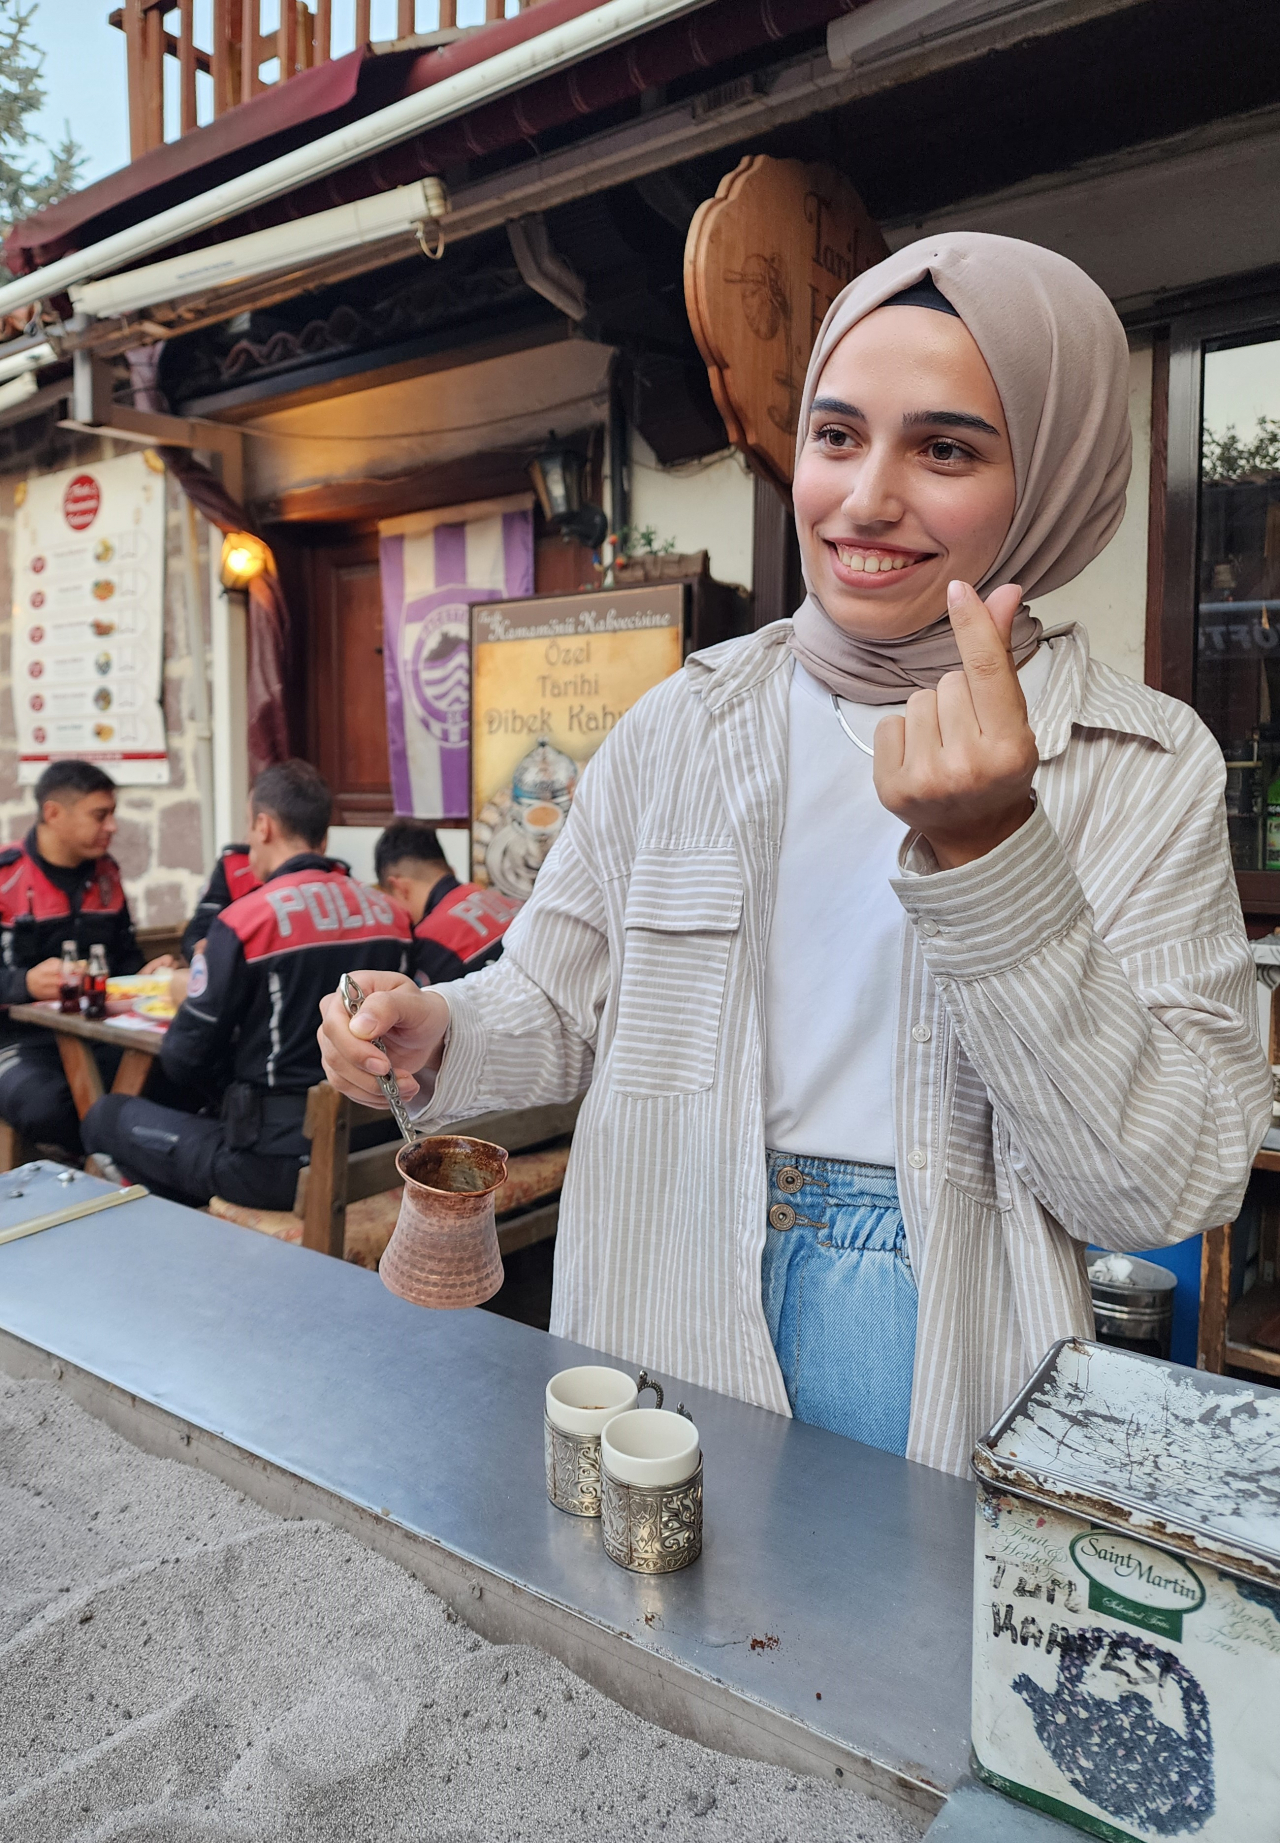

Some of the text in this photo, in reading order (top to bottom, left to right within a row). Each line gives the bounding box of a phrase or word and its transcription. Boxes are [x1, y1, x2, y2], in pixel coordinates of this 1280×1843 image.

[544, 638, 592, 667] Özel
[536, 673, 600, 699] Tarihi
[485, 705, 553, 735] Dibek
[1006, 1521, 1048, 1547] Fruit
[992, 1534, 1056, 1567] Herbal
[1081, 1537, 1198, 1602] Saint Martin
[1195, 1623, 1240, 1656] Teas
